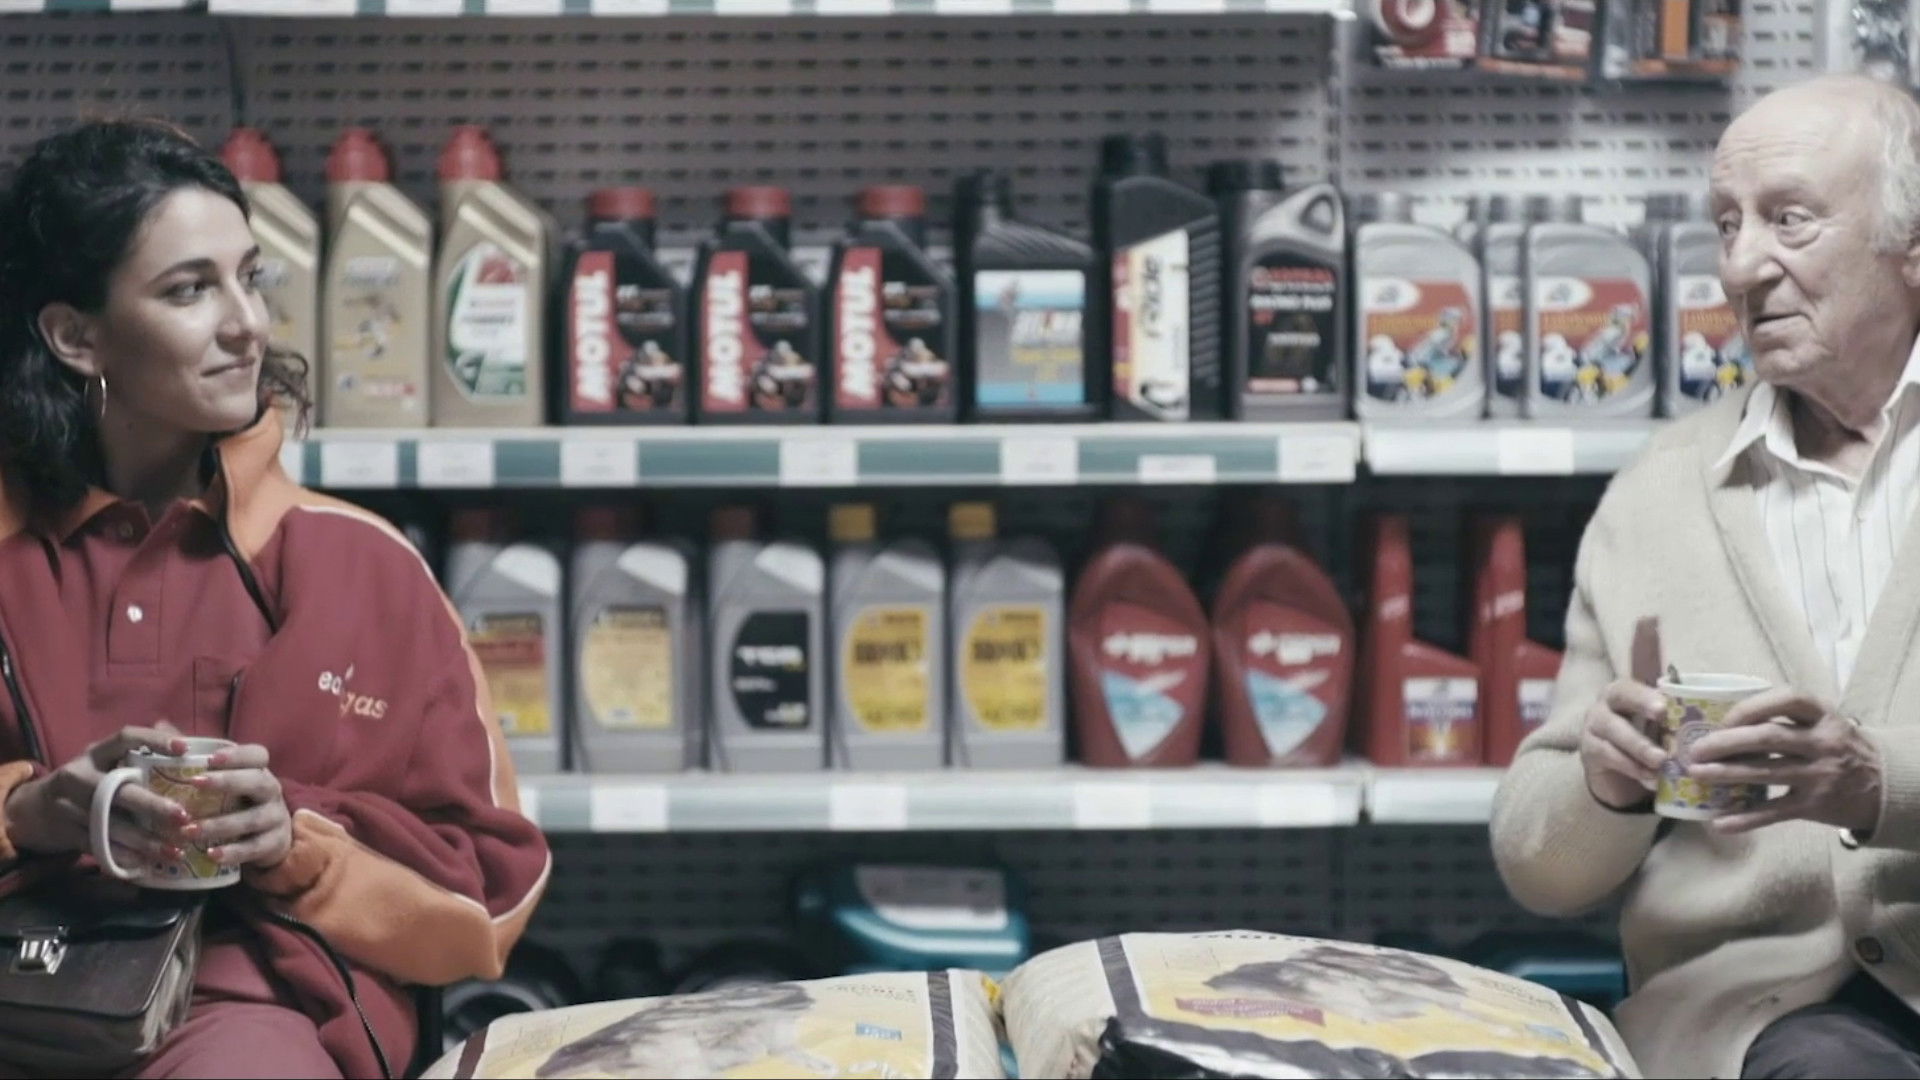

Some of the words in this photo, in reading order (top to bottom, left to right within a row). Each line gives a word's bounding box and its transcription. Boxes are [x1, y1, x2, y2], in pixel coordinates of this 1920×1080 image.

[574, 269, 611, 404] MOTUL
[706, 269, 743, 404] MOTUL
[840, 265, 877, 401] MOTUL
